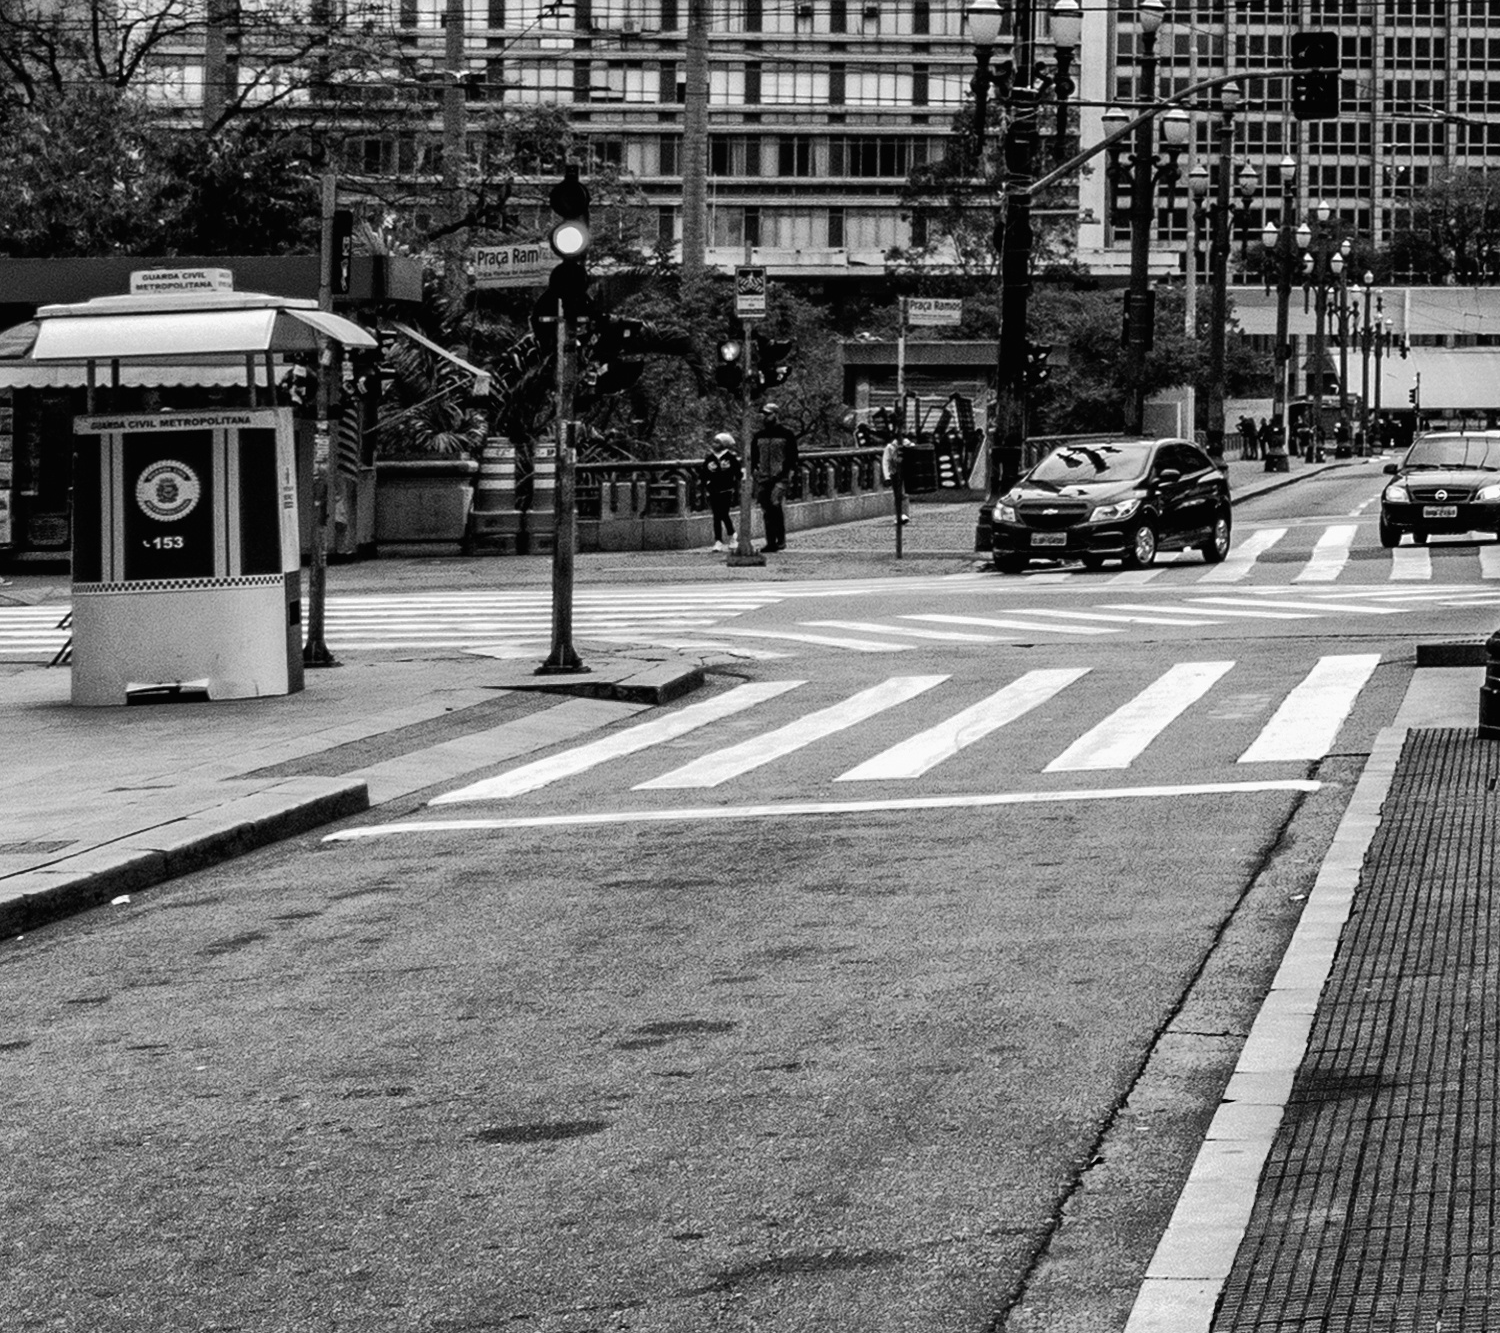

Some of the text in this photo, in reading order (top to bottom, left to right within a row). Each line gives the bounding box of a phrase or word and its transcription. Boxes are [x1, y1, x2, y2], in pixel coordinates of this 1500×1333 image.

[477, 250, 508, 269] Praça
[142, 272, 180, 281] GUARDA
[182, 271, 207, 280] CIVIL
[135, 280, 213, 291] METROPOLITANA
[90, 416, 252, 430] GUARDA CIVIL METROPOLITANA
[152, 536, 184, 549] 153
